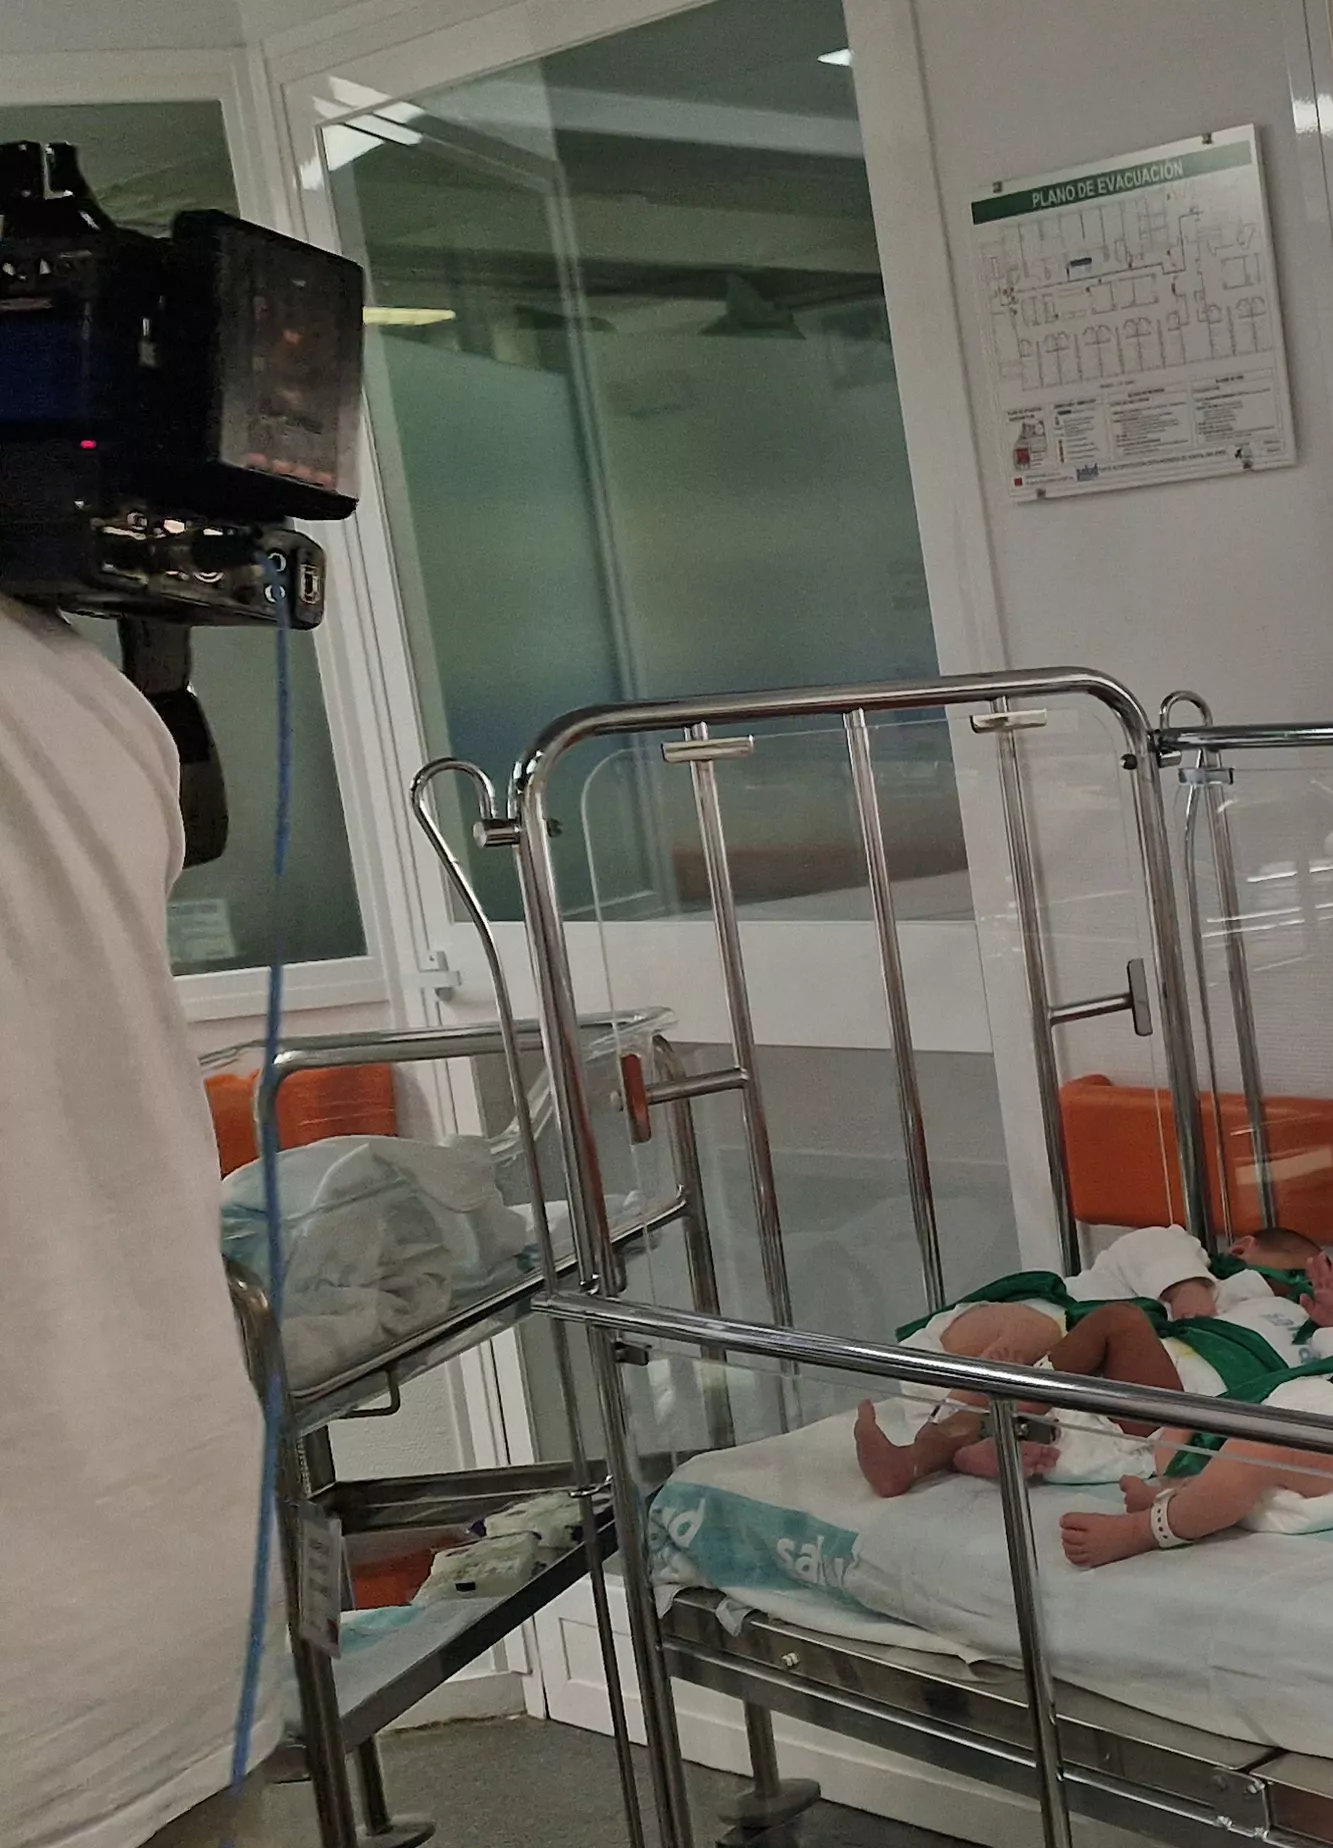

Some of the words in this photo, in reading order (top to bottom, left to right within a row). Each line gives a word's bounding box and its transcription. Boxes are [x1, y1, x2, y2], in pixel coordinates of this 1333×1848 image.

[1031, 186, 1076, 208] PLANO
[1077, 180, 1096, 199] DE
[1097, 158, 1184, 194] EVACUACIÓN
[776, 1535, 852, 1588] salu
